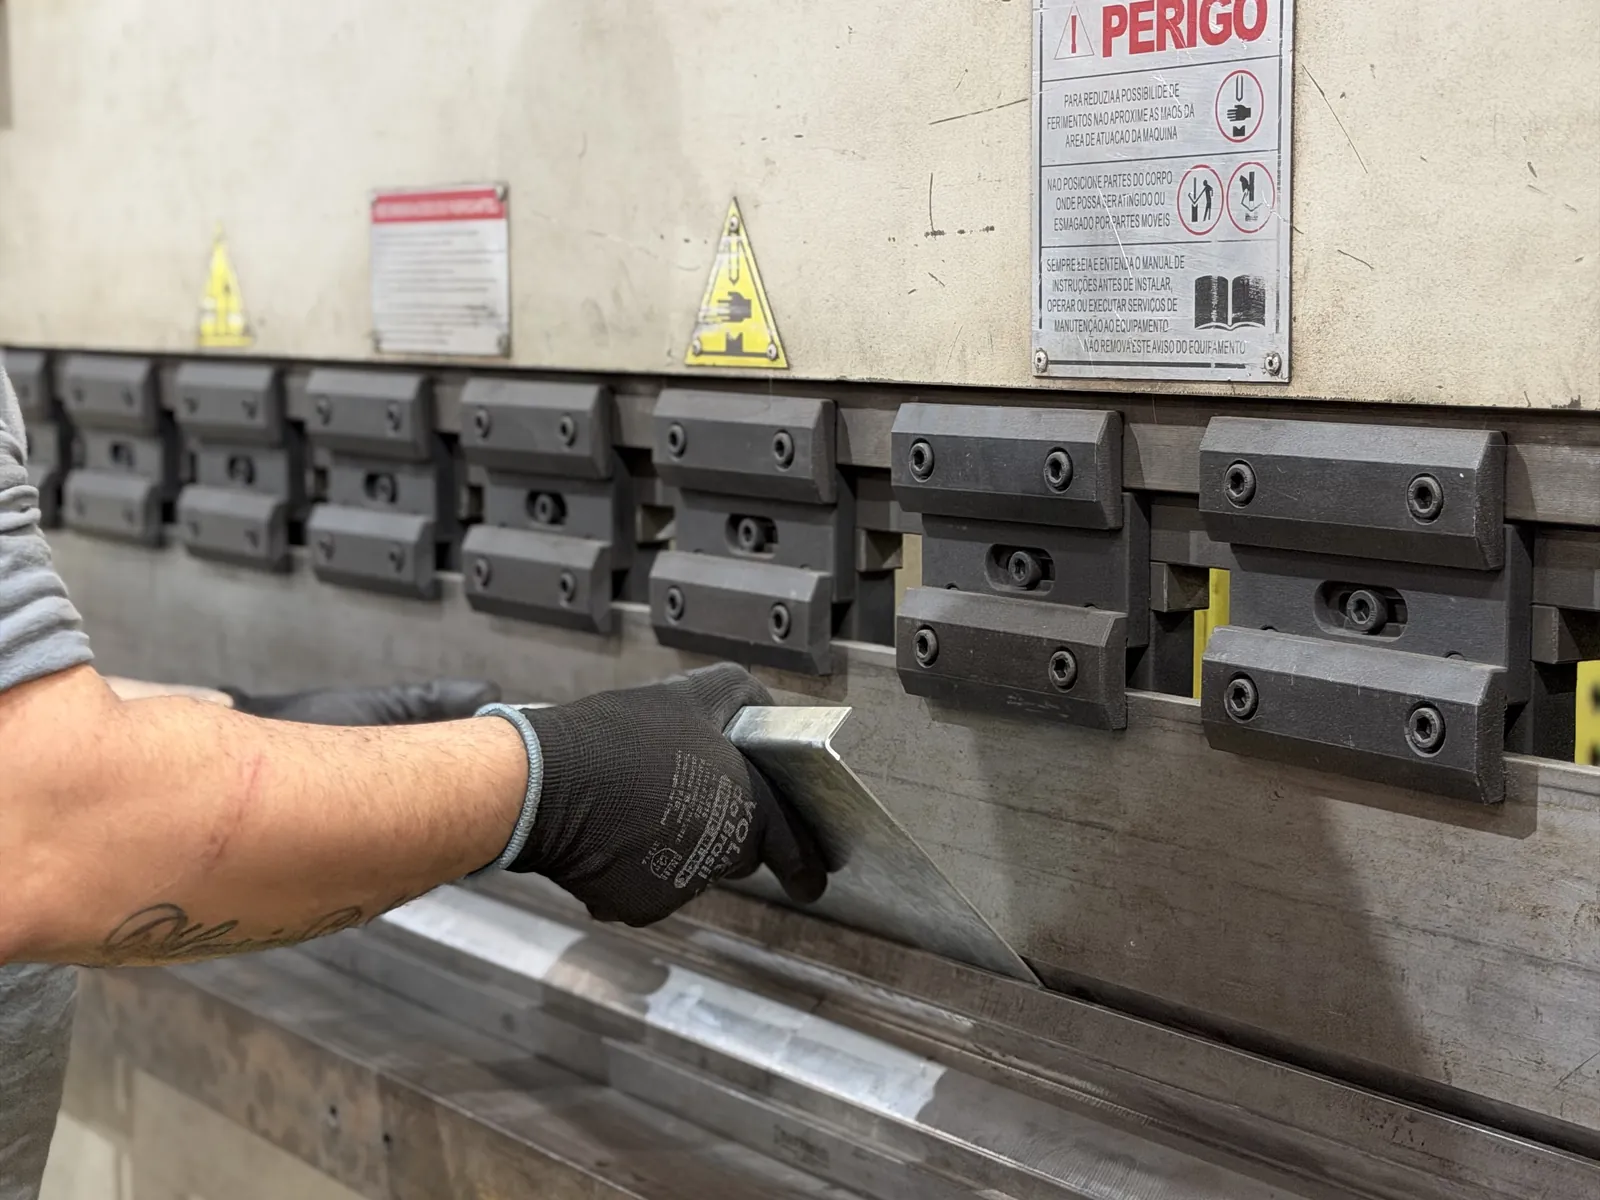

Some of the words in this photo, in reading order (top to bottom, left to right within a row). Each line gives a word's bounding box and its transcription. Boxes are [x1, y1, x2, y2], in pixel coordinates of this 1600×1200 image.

[1102, 0, 1268, 58] PERIGO
[1064, 92, 1082, 108] PARA
[1121, 85, 1168, 101] POSSIBILIDE
[1169, 83, 1180, 98] DE
[1047, 112, 1092, 130] FERIMENTOS
[1093, 111, 1108, 126] NAO
[1109, 107, 1148, 124] APROXIME
[1149, 107, 1159, 121] AS
[1184, 104, 1195, 119] DA
[1065, 133, 1084, 148] AREA
[1085, 132, 1095, 147] DE
[1132, 129, 1142, 143] DA
[1143, 125, 1178, 142] MAQUINA
[1063, 174, 1102, 191] POSICIONE
[1103, 173, 1132, 189] PARTES
[1133, 172, 1144, 187] DO
[1145, 170, 1173, 186] CORPO
[1056, 196, 1076, 211] ONDE
[1077, 194, 1101, 210] POSSA
[1102, 193, 1117, 209] SER
[1118, 191, 1153, 208] ATINGIDO
[1154, 191, 1166, 206] OU
[1053, 216, 1094, 232] ESMAGADO
[1095, 215, 1110, 230] POR
[1111, 213, 1140, 230] PARTES
[1141, 212, 1171, 228] MOVEIS
[1046, 257, 1076, 273] SEMPRE
[1077, 257, 1093, 272] LEIA
[1100, 256, 1135, 272] ENTENDA
[1142, 255, 1174, 270] MANUAL
[1174, 255, 1186, 270] DE
[1052, 274, 1098, 295] INSTRUÇÕES
[1098, 277, 1122, 293] ANTES
[1123, 277, 1134, 292] DE
[1135, 276, 1174, 293] INSTALAR,
[1047, 298, 1076, 313] OPERAR
[1077, 299, 1088, 312] OU
[1088, 298, 1127, 312] EXECUTAR
[1127, 298, 1166, 314] SERVIÇOS
[1167, 297, 1178, 312] DE
[1054, 315, 1103, 334] MANUTENÇÃO
[1104, 318, 1115, 333] AO
[1115, 318, 1170, 333] EQUIPAMENTO
[1084, 335, 1099, 353] NÃO
[1100, 339, 1131, 354] REMOVA
[1131, 340, 1151, 354] ESTE
[1152, 340, 1175, 354] AVISO
[1175, 340, 1187, 354] DO
[1188, 340, 1246, 355] EQUIPAMENTO
